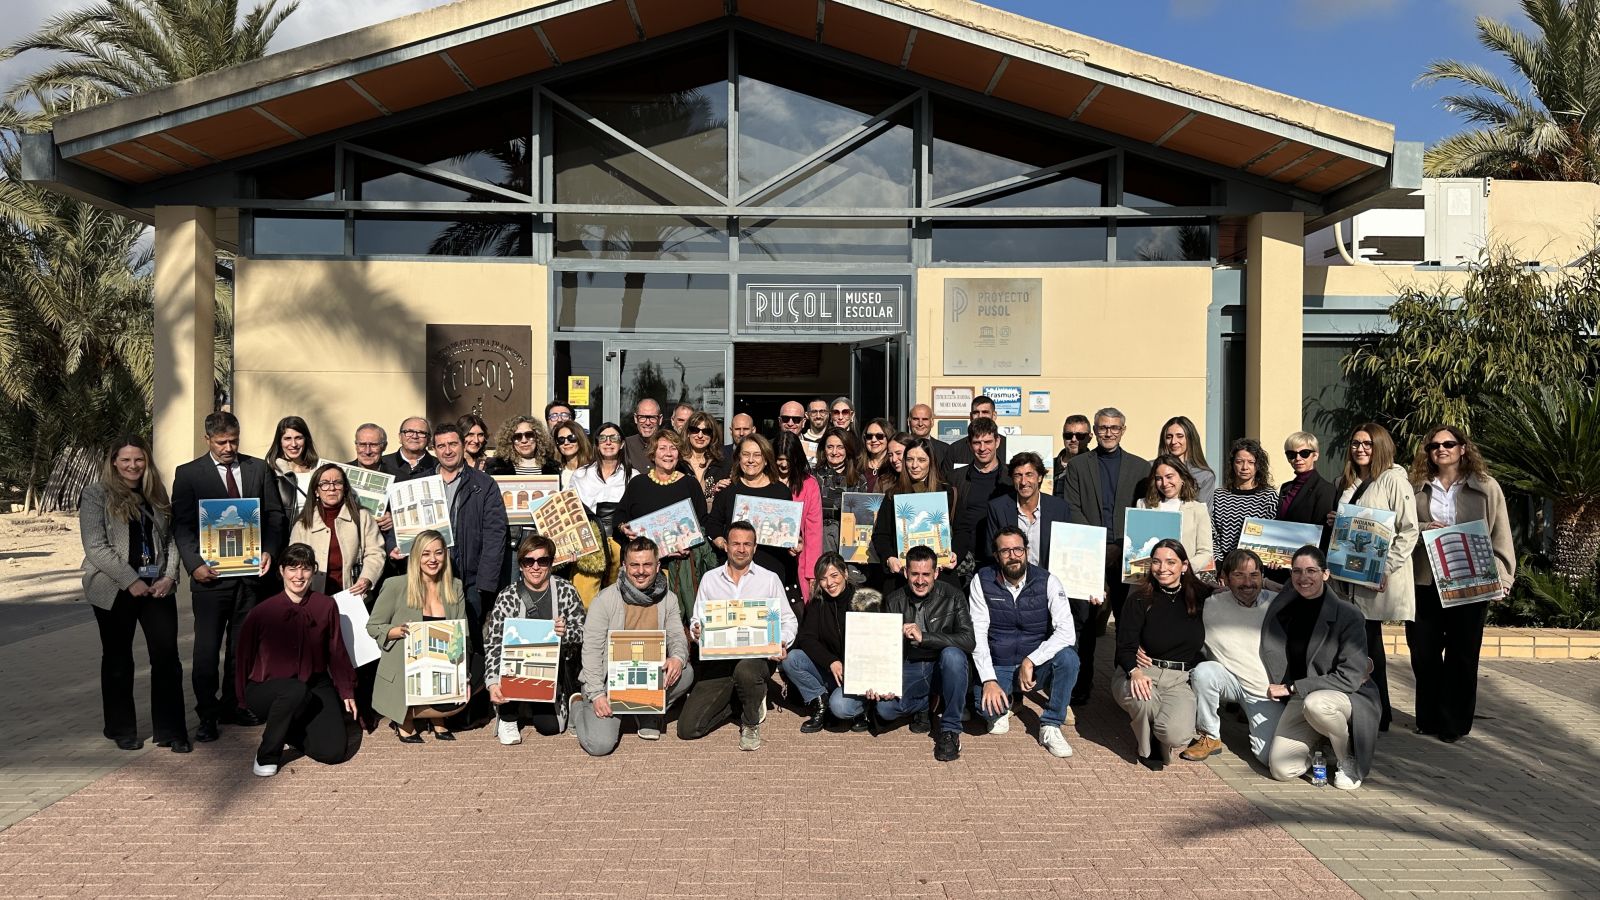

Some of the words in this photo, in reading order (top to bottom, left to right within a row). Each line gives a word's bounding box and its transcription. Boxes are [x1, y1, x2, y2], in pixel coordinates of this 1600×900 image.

[845, 292, 882, 304] MUSEO
[977, 291, 1030, 303] PROYECTO
[756, 291, 833, 323] PUÇOL
[845, 306, 893, 318] ESCOLAR
[977, 305, 1011, 317] PUSOL
[986, 391, 1018, 399] Erasmus+
